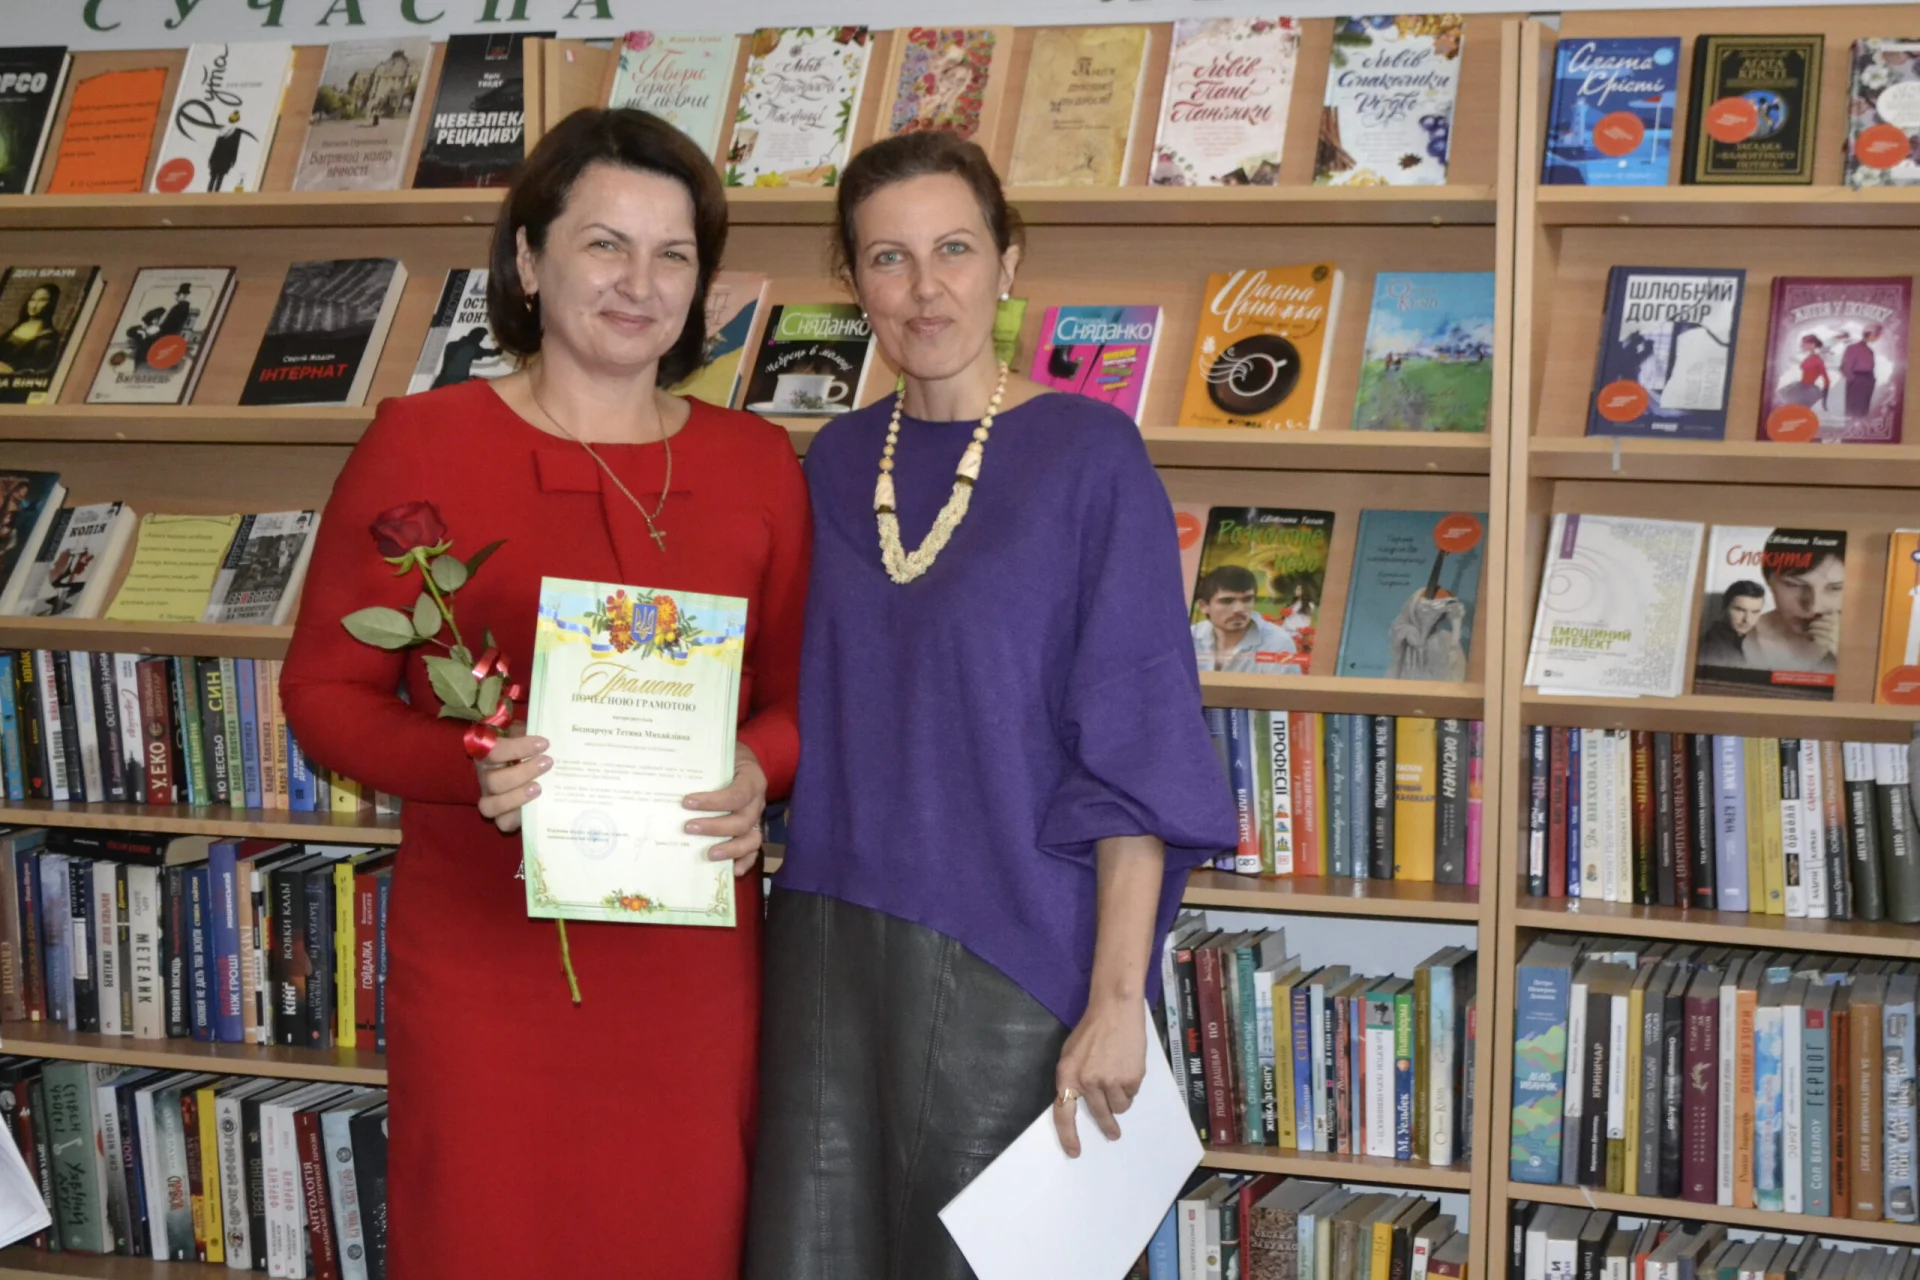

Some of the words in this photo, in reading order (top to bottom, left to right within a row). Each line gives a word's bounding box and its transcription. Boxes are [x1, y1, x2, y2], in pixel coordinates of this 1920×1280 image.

[1568, 41, 1654, 74] Агата
[1577, 70, 1665, 106] Крісті
[436, 127, 522, 146] РЕЦИДИВУ
[1629, 279, 1733, 302] ШЛЮБНИЙ
[1626, 303, 1713, 323] ДОГОВІР
[259, 364, 348, 382] ІНТЕРНАТ
[1726, 545, 1813, 575] Спокута
[1549, 636, 1612, 650] ІНТЕЛЕКТ
[1551, 626, 1632, 643] ЕМОЦІЙНИЙ
[206, 671, 223, 711] СИН
[636, 698, 697, 712] ГРАМОТОЮ
[149, 742, 167, 774] ЕКО
[1272, 720, 1289, 796] ПРОФЕСІЇ
[1586, 739, 1598, 823] ВИХОВАТИ
[282, 919, 292, 959] ВОВКИ
[135, 933, 152, 1003] МЕТЕЛИК
[170, 957, 181, 988] МІСЯЦЬ
[226, 955, 238, 990] ГРОШІ
[361, 941, 373, 990] ГОЙДАЛКА
[170, 989, 181, 1023] ПОВНИЙ
[228, 993, 240, 1015] НІЖ
[1210, 1048, 1224, 1087] ДАШВАР
[1261, 1065, 1273, 1090] СНІГУ
[1592, 1042, 1604, 1098] КРИНИЧАР
[1805, 1042, 1825, 1107] ГЕРЦОГ
[1264, 1092, 1273, 1101] ЗІ
[1264, 1102, 1276, 1132] ЖІНКА
[1397, 1093, 1410, 1135] Уельбек
[303, 1161, 321, 1234] АНТОЛОГІЯ
